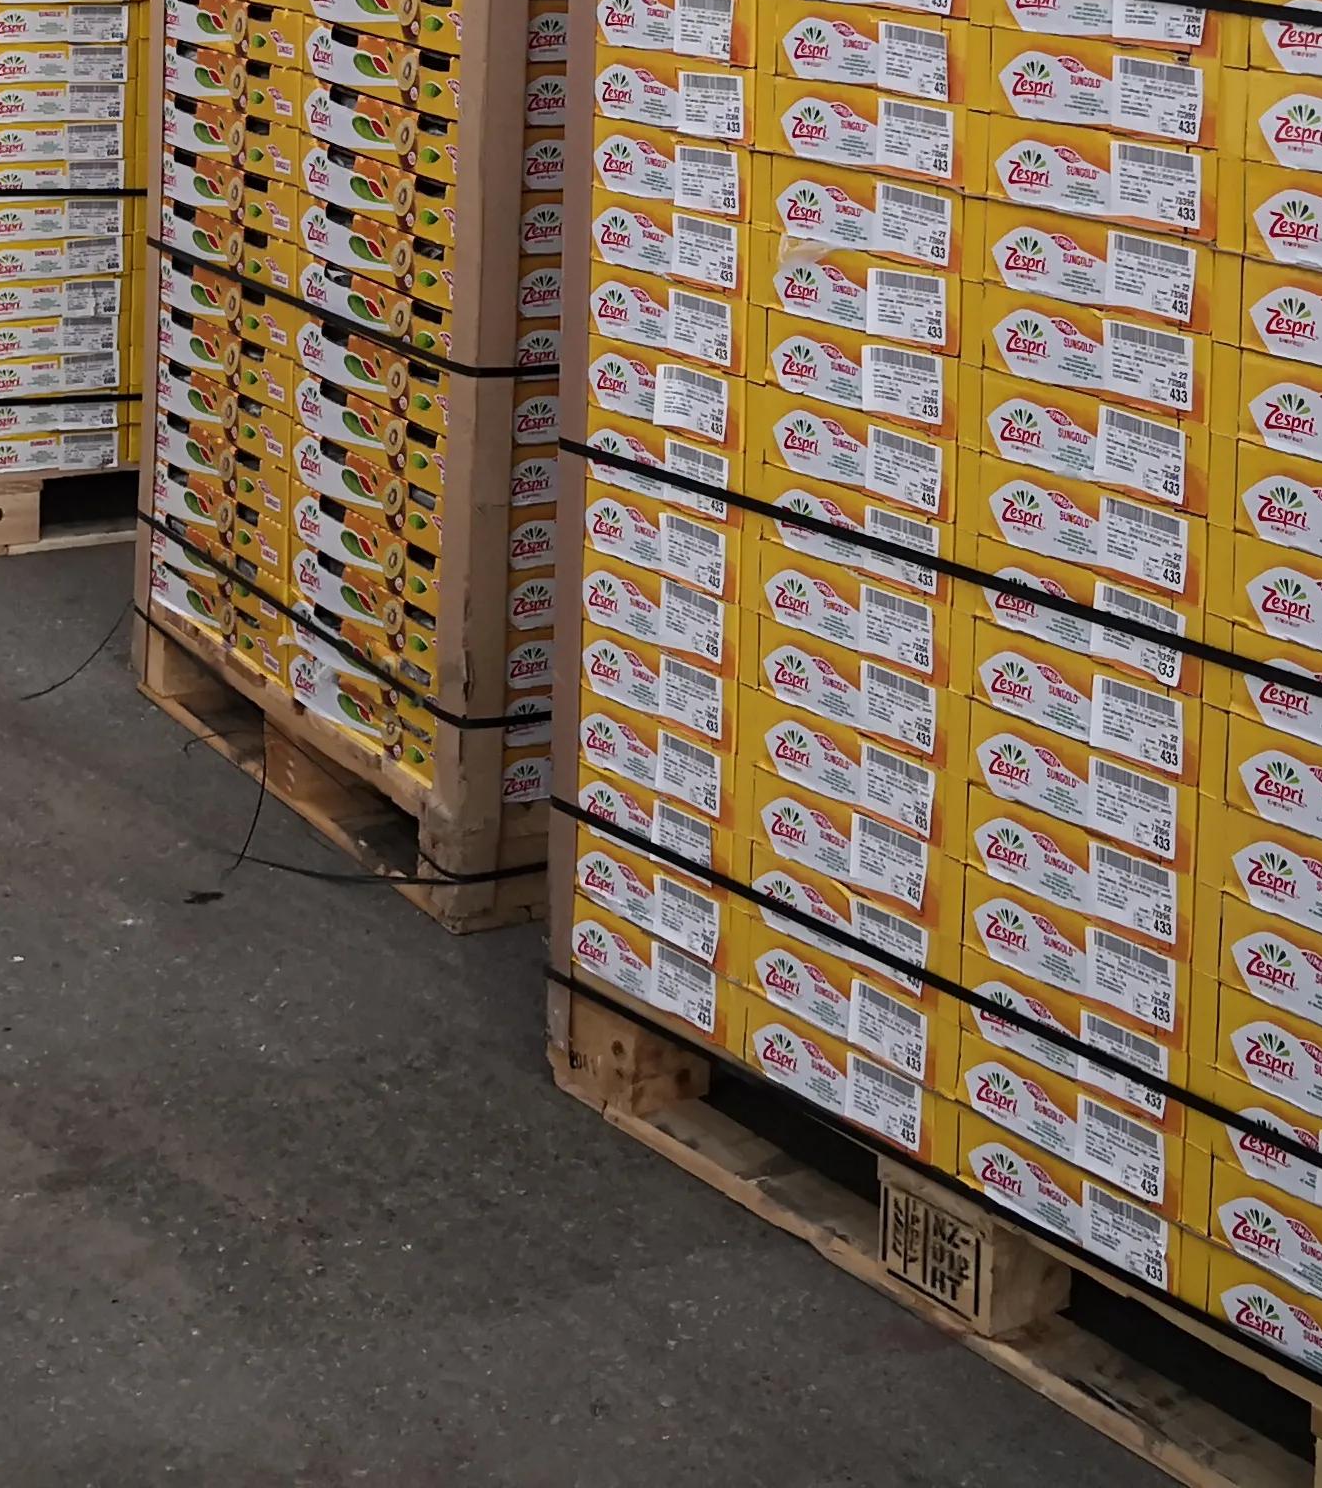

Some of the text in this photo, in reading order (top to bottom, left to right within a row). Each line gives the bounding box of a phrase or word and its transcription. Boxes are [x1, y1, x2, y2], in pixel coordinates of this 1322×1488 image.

[1011, 72, 1056, 98] Zespri
[1070, 74, 1101, 87] SUNGOLD
[792, 118, 828, 139] Zespri
[603, 155, 633, 176] Zespri
[1269, 211, 1320, 241] Zespri
[1169, 385, 1188, 403] 433
[1001, 498, 1045, 528] Zespri
[1256, 497, 1307, 528] Zespri
[776, 585, 809, 613] Zespri
[988, 751, 1030, 785] Zespri
[1254, 768, 1304, 802] Zespri
[1152, 1007, 1170, 1022] 433
[1245, 1039, 1294, 1078] Zespri
[982, 1157, 1024, 1195] Zespri
[1233, 1213, 1280, 1254] Zespri
